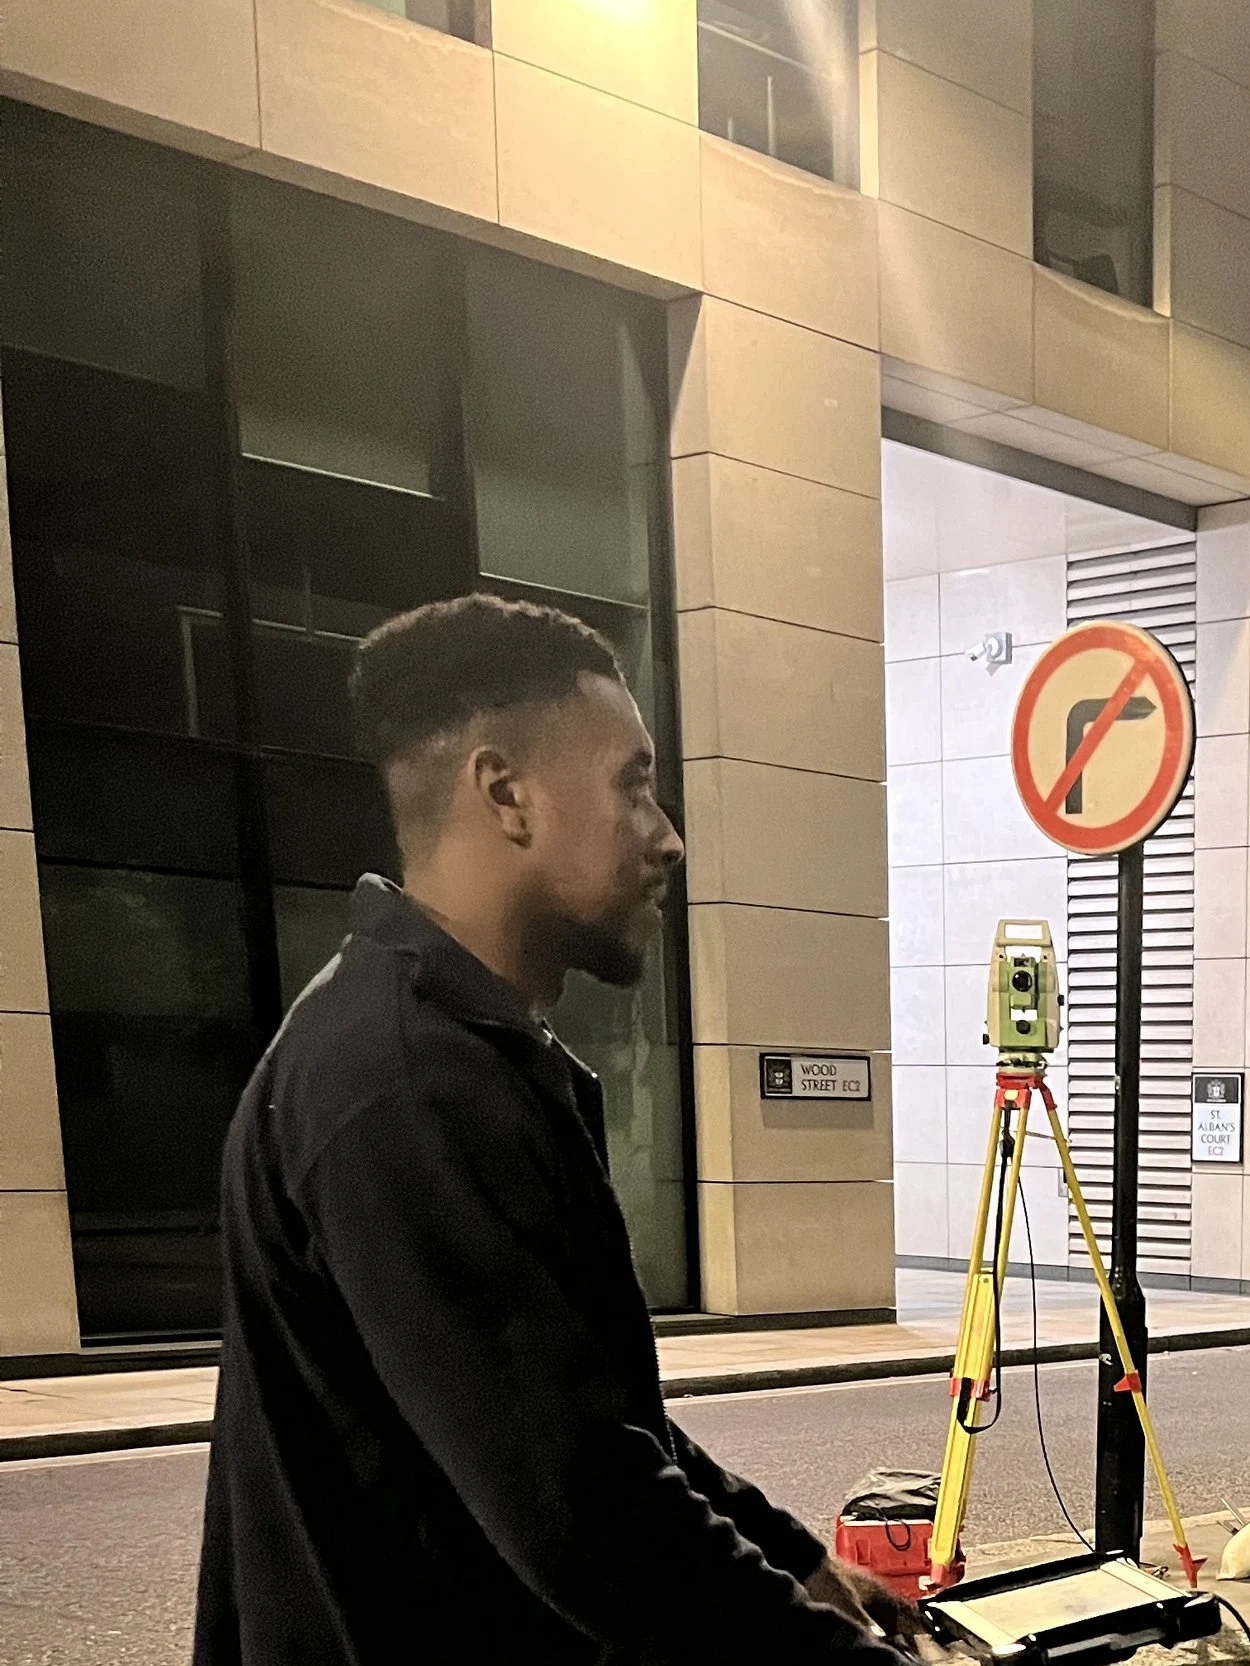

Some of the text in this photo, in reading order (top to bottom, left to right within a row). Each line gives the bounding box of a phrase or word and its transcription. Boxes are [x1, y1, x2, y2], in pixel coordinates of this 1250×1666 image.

[801, 1064, 837, 1076] WOOD
[801, 1079, 861, 1092] STREET EC2
[1198, 1122, 1235, 1133] ALBAN'S
[1201, 1134, 1231, 1144] COURT
[1208, 1146, 1224, 1156] EC2
